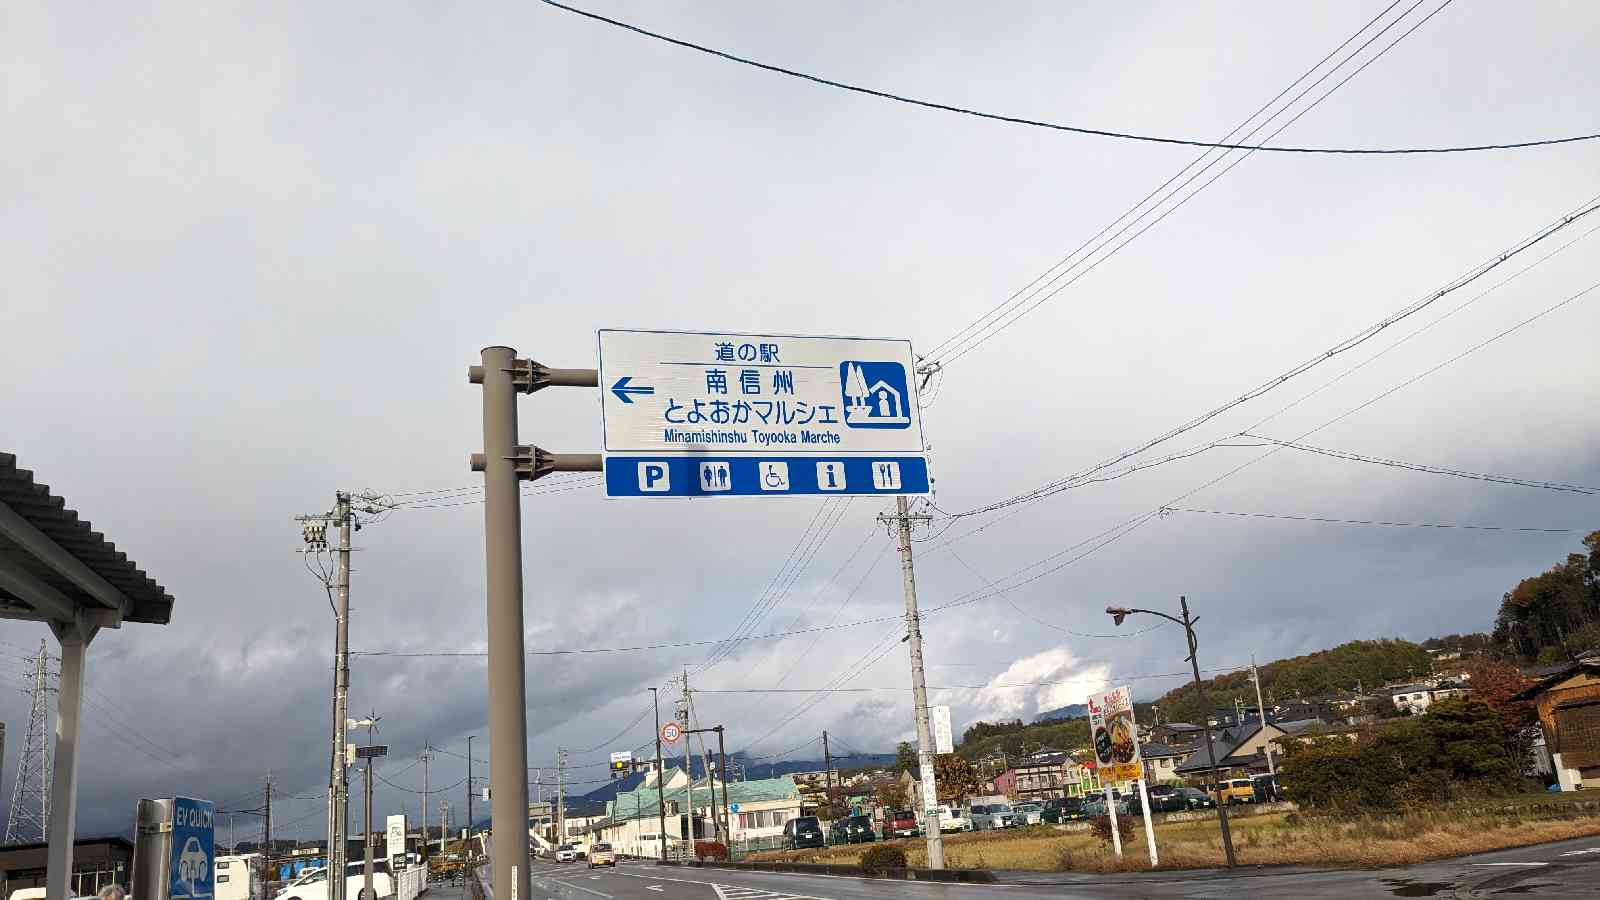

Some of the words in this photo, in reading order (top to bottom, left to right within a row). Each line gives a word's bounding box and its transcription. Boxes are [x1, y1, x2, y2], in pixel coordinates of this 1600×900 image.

[715, 342, 780, 363] 道の駅
[705, 368, 795, 395] 南信州
[665, 398, 838, 424] とよおかマルシェ
[664, 429, 747, 443] Minamishinshu
[752, 430, 797, 446] Toyooka
[801, 430, 841, 444] Marche
[646, 465, 663, 488] P
[666, 728, 677, 737] 50
[177, 808, 188, 826] EV
